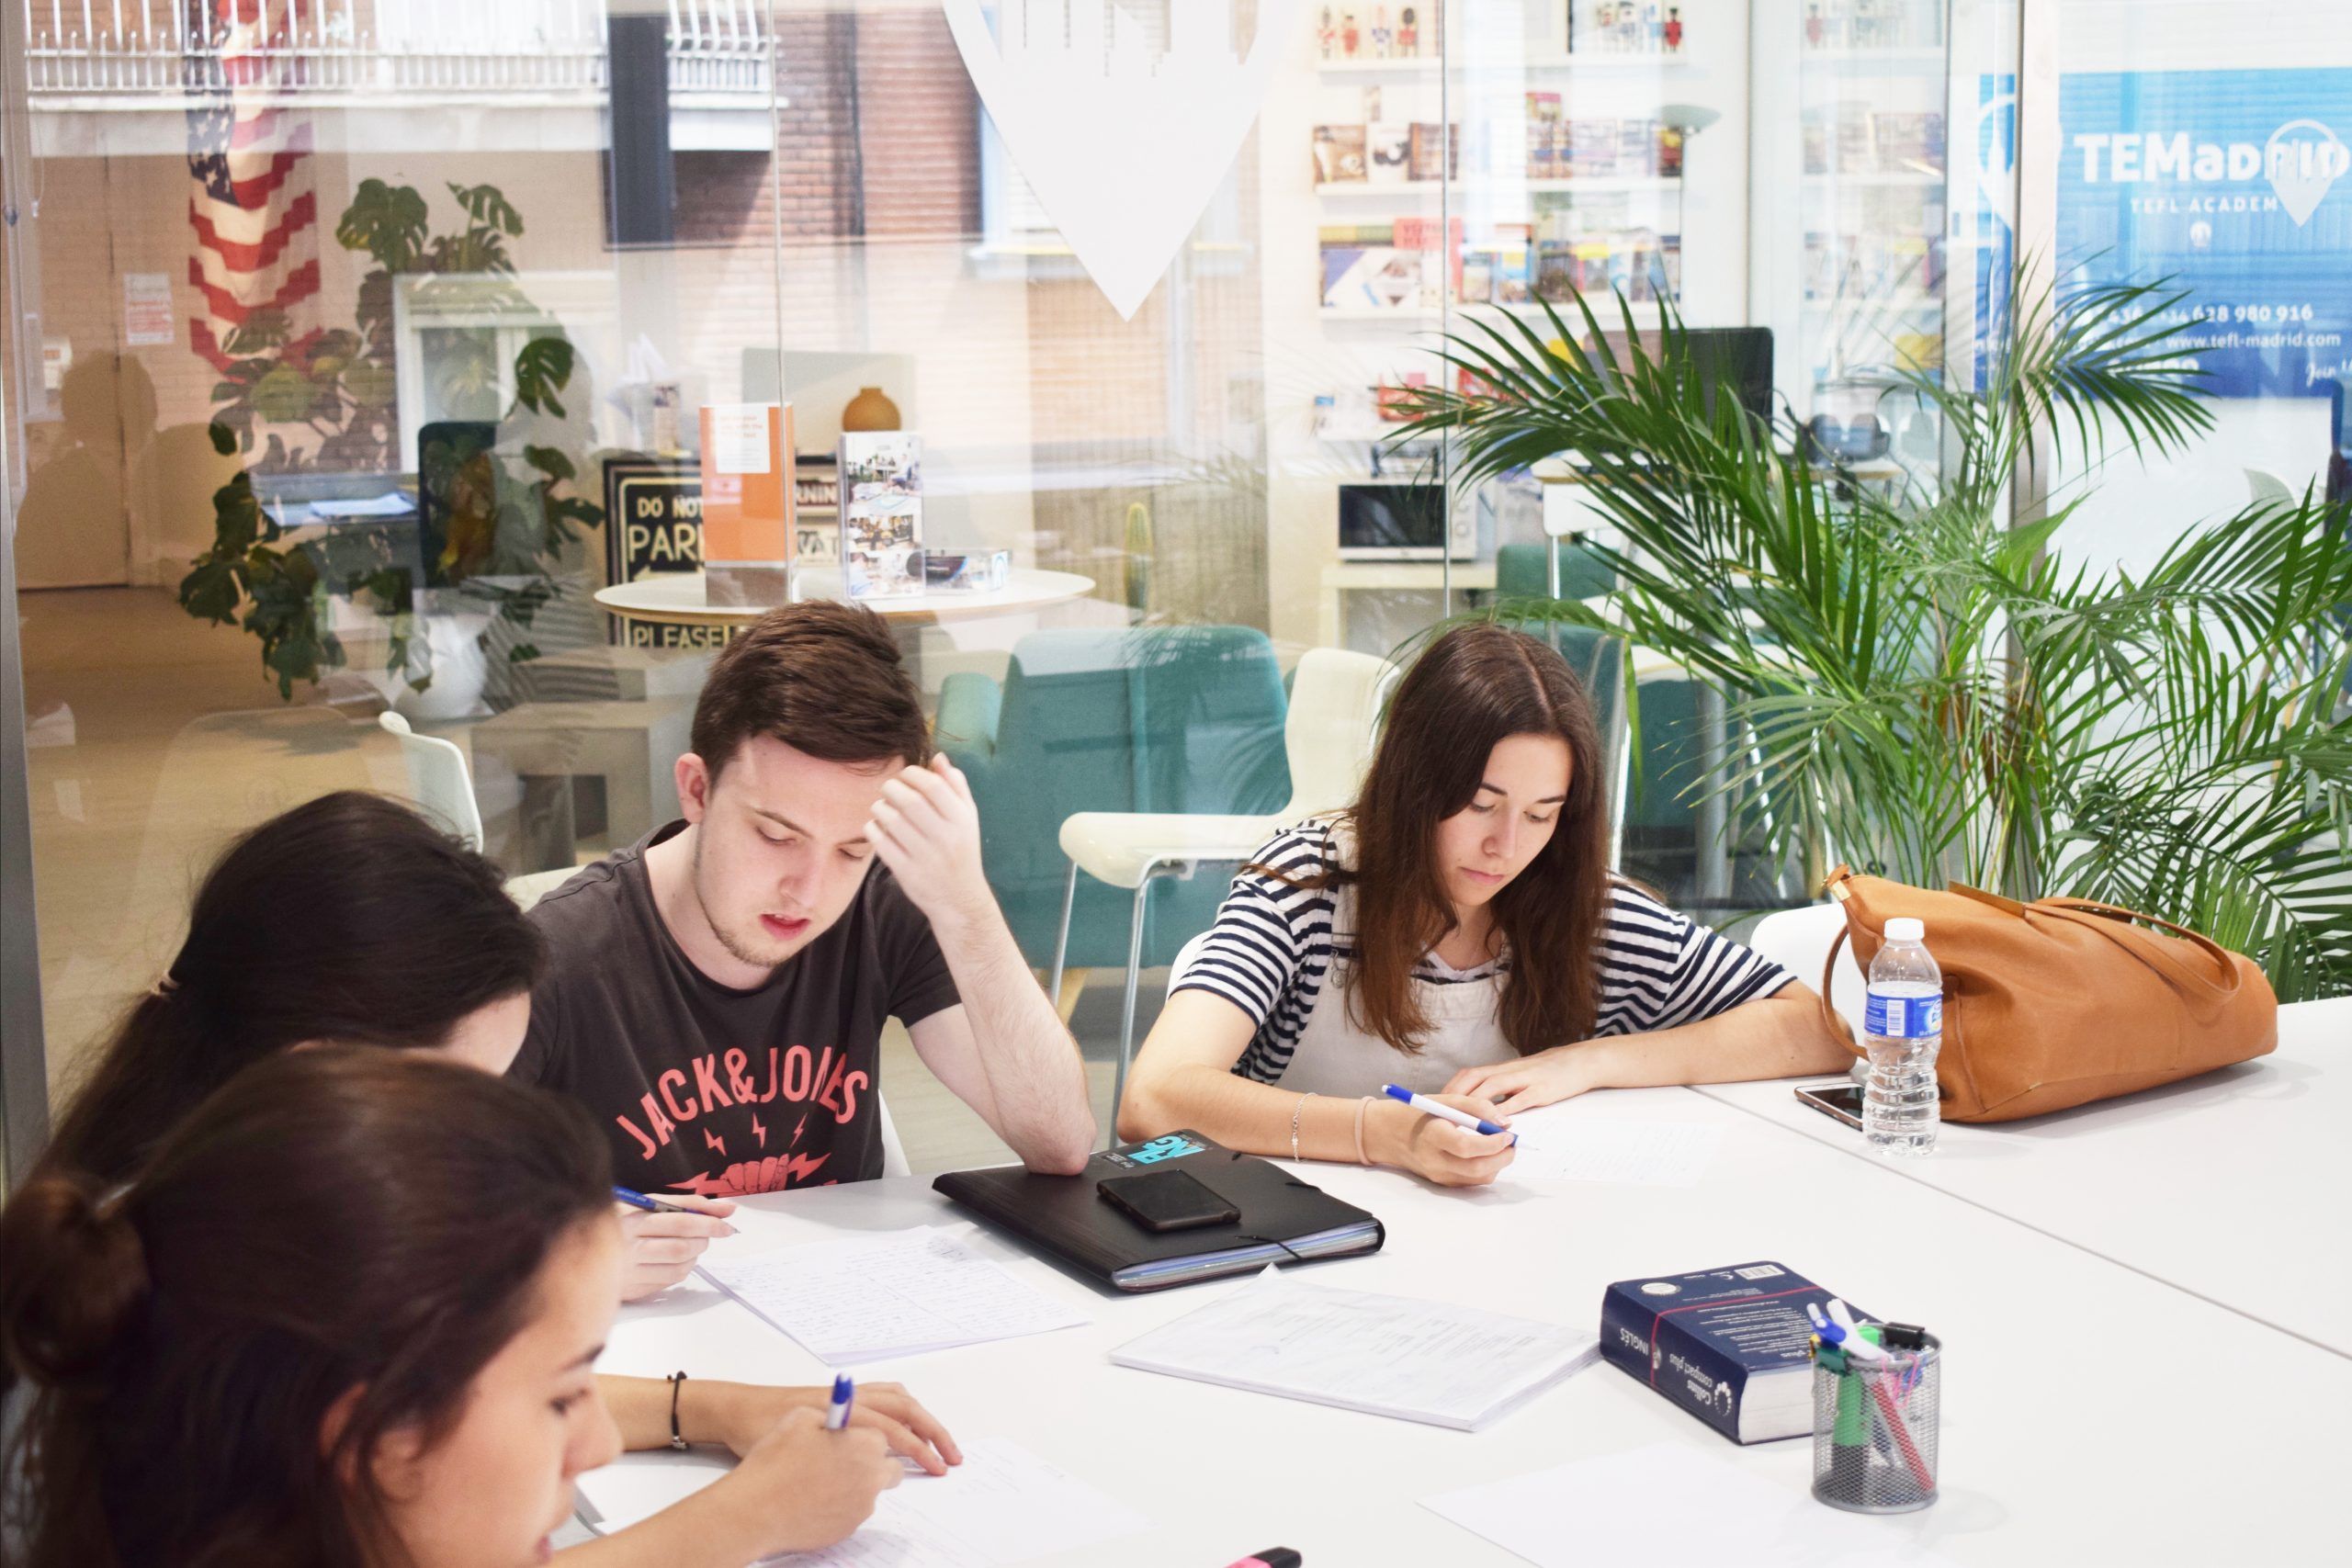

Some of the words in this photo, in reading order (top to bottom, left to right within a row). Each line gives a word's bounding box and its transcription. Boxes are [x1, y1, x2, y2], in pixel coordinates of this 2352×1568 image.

[2131, 197, 2179, 214] TEFL
[2188, 196, 2278, 213] ACADEM
[2192, 304, 2230, 322] 628
[2234, 305, 2271, 322] 980
[2276, 303, 2313, 322] 916
[2165, 332, 2342, 349] www.tefl-madrid.com
[638, 496, 663, 518] DO
[633, 626, 721, 647] PLEASE
[1620, 1327, 1649, 1356] INGLÉS
[1669, 1353, 1686, 1371] plus
[1683, 1365, 1713, 1388] compact
[1687, 1379, 1712, 1404] Collins
